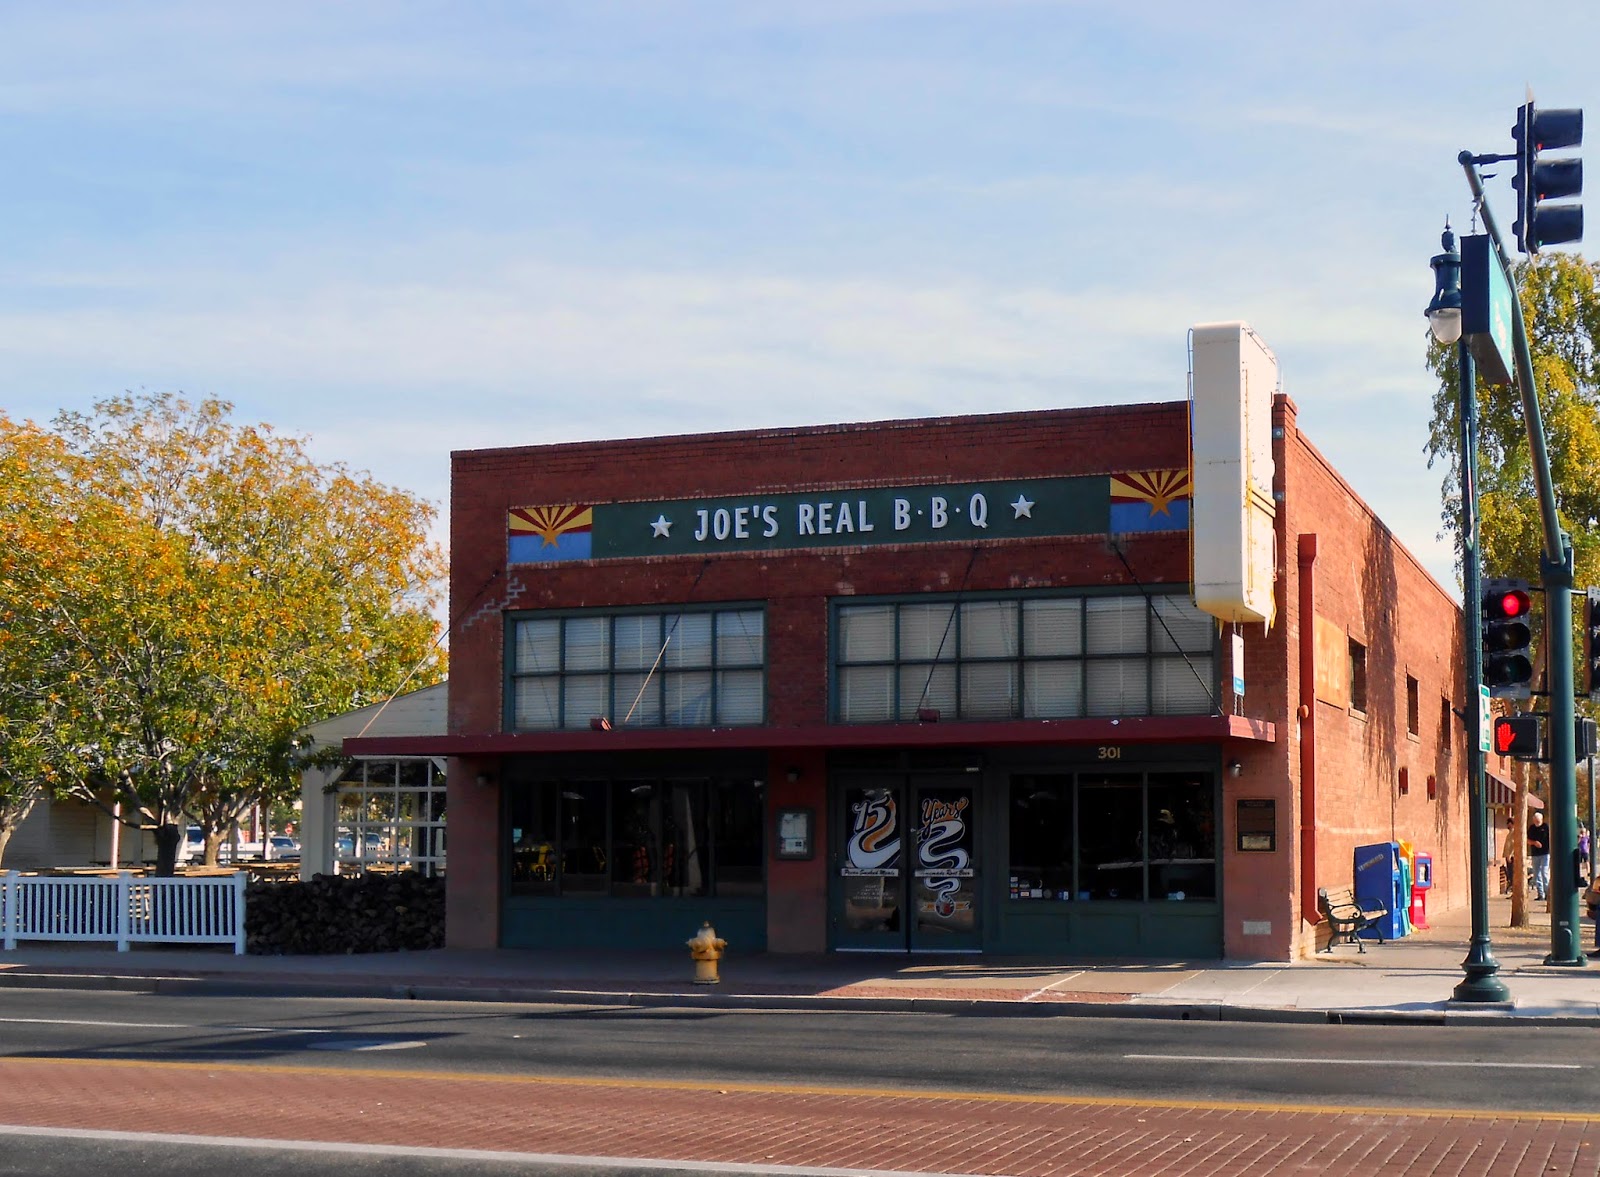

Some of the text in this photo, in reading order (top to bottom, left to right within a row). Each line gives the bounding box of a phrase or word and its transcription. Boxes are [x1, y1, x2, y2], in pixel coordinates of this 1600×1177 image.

[694, 505, 779, 542] JOE'S
[799, 500, 874, 536] REAL
[1098, 746, 1121, 759] 301
